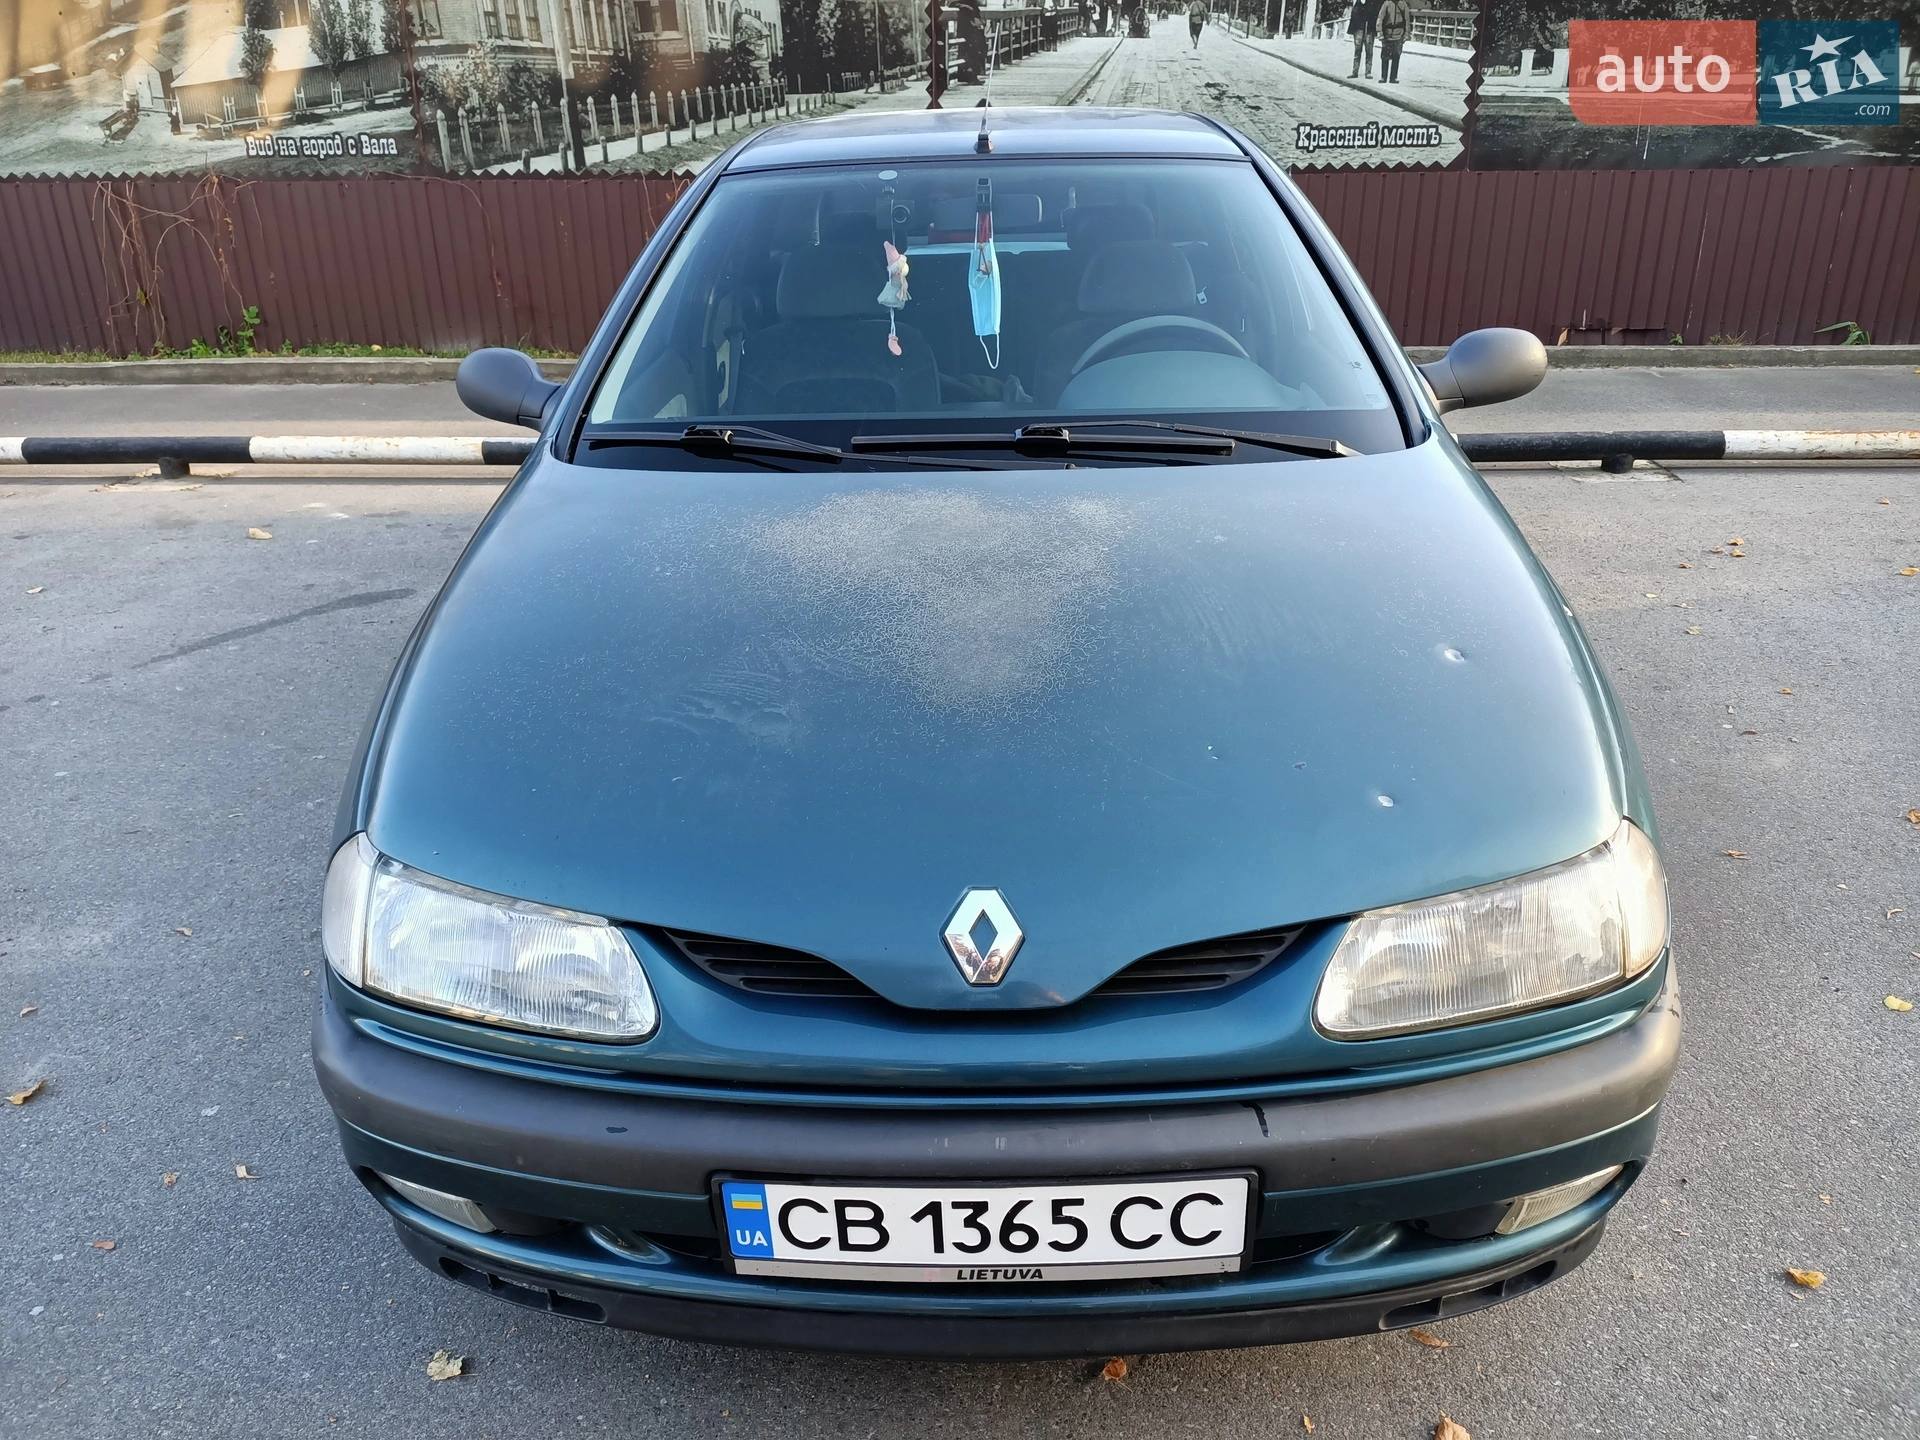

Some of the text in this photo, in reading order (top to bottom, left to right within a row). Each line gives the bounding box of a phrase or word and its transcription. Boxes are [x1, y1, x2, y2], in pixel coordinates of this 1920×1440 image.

[247, 134, 397, 159] Вид на город с Вала
[1298, 124, 1440, 150] Крассный мостъ
[778, 1193, 1224, 1254] CB 1365 CC
[736, 1230, 768, 1247] UA
[957, 1268, 1043, 1281] LIETUVA
